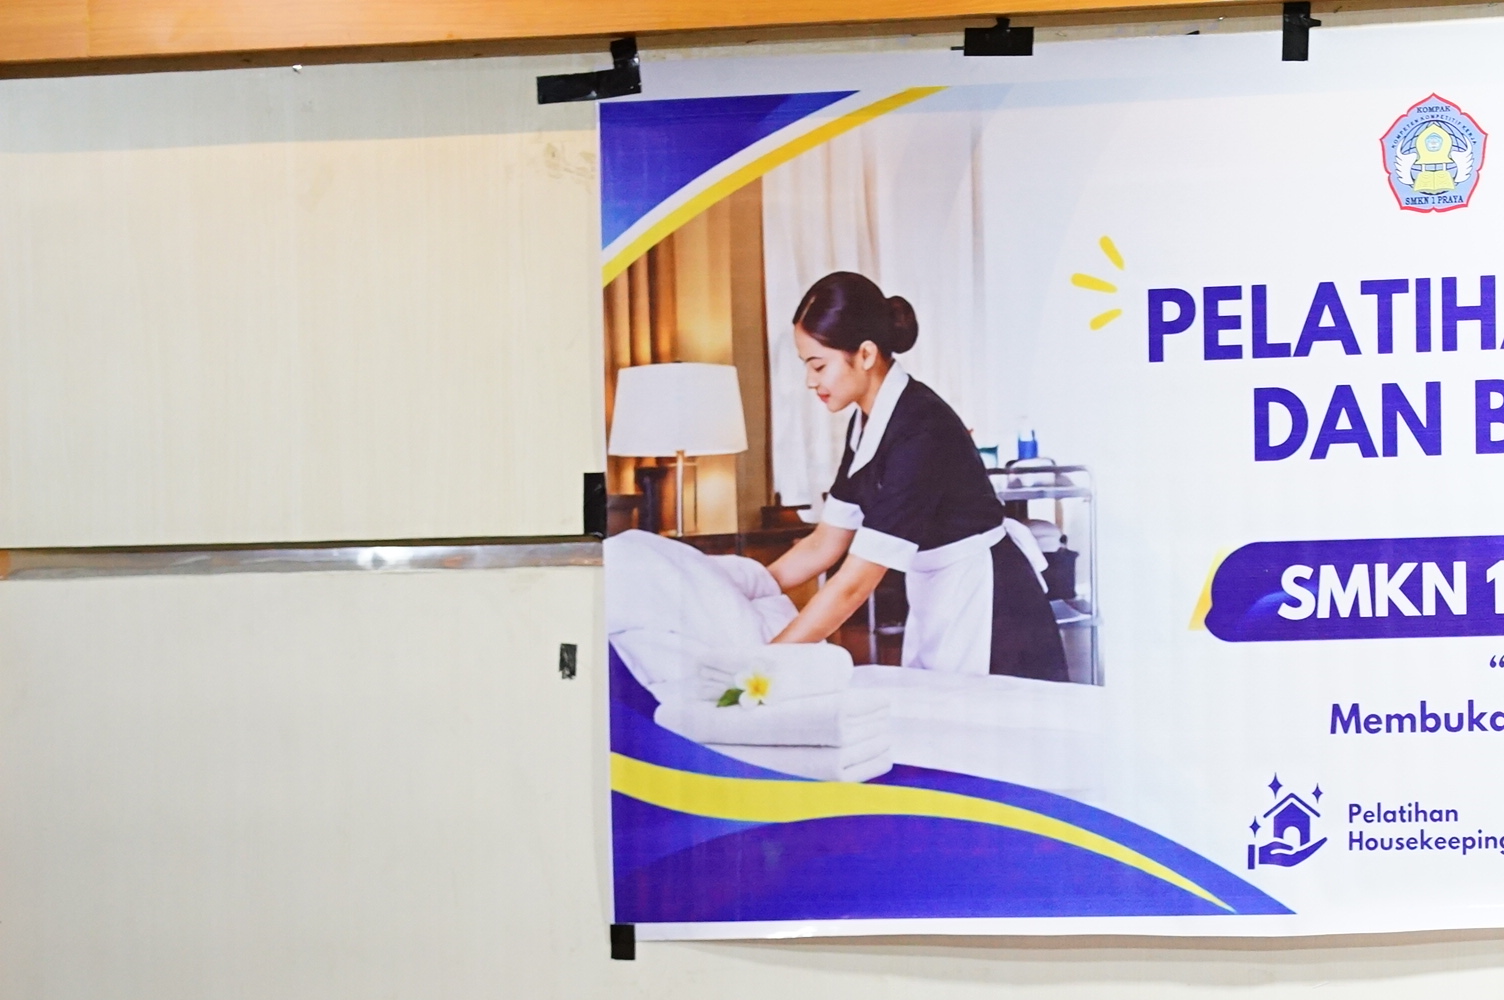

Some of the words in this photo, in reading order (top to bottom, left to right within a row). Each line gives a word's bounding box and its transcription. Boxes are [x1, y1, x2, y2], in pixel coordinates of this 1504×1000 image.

[1416, 105, 1451, 114] KOMPAK
[1405, 196, 1429, 205] SMKN
[1437, 195, 1464, 204] PRAYA
[1253, 380, 1442, 462] DAN
[1277, 560, 1467, 621] SMKN
[1348, 802, 1459, 824] Pelatihan
